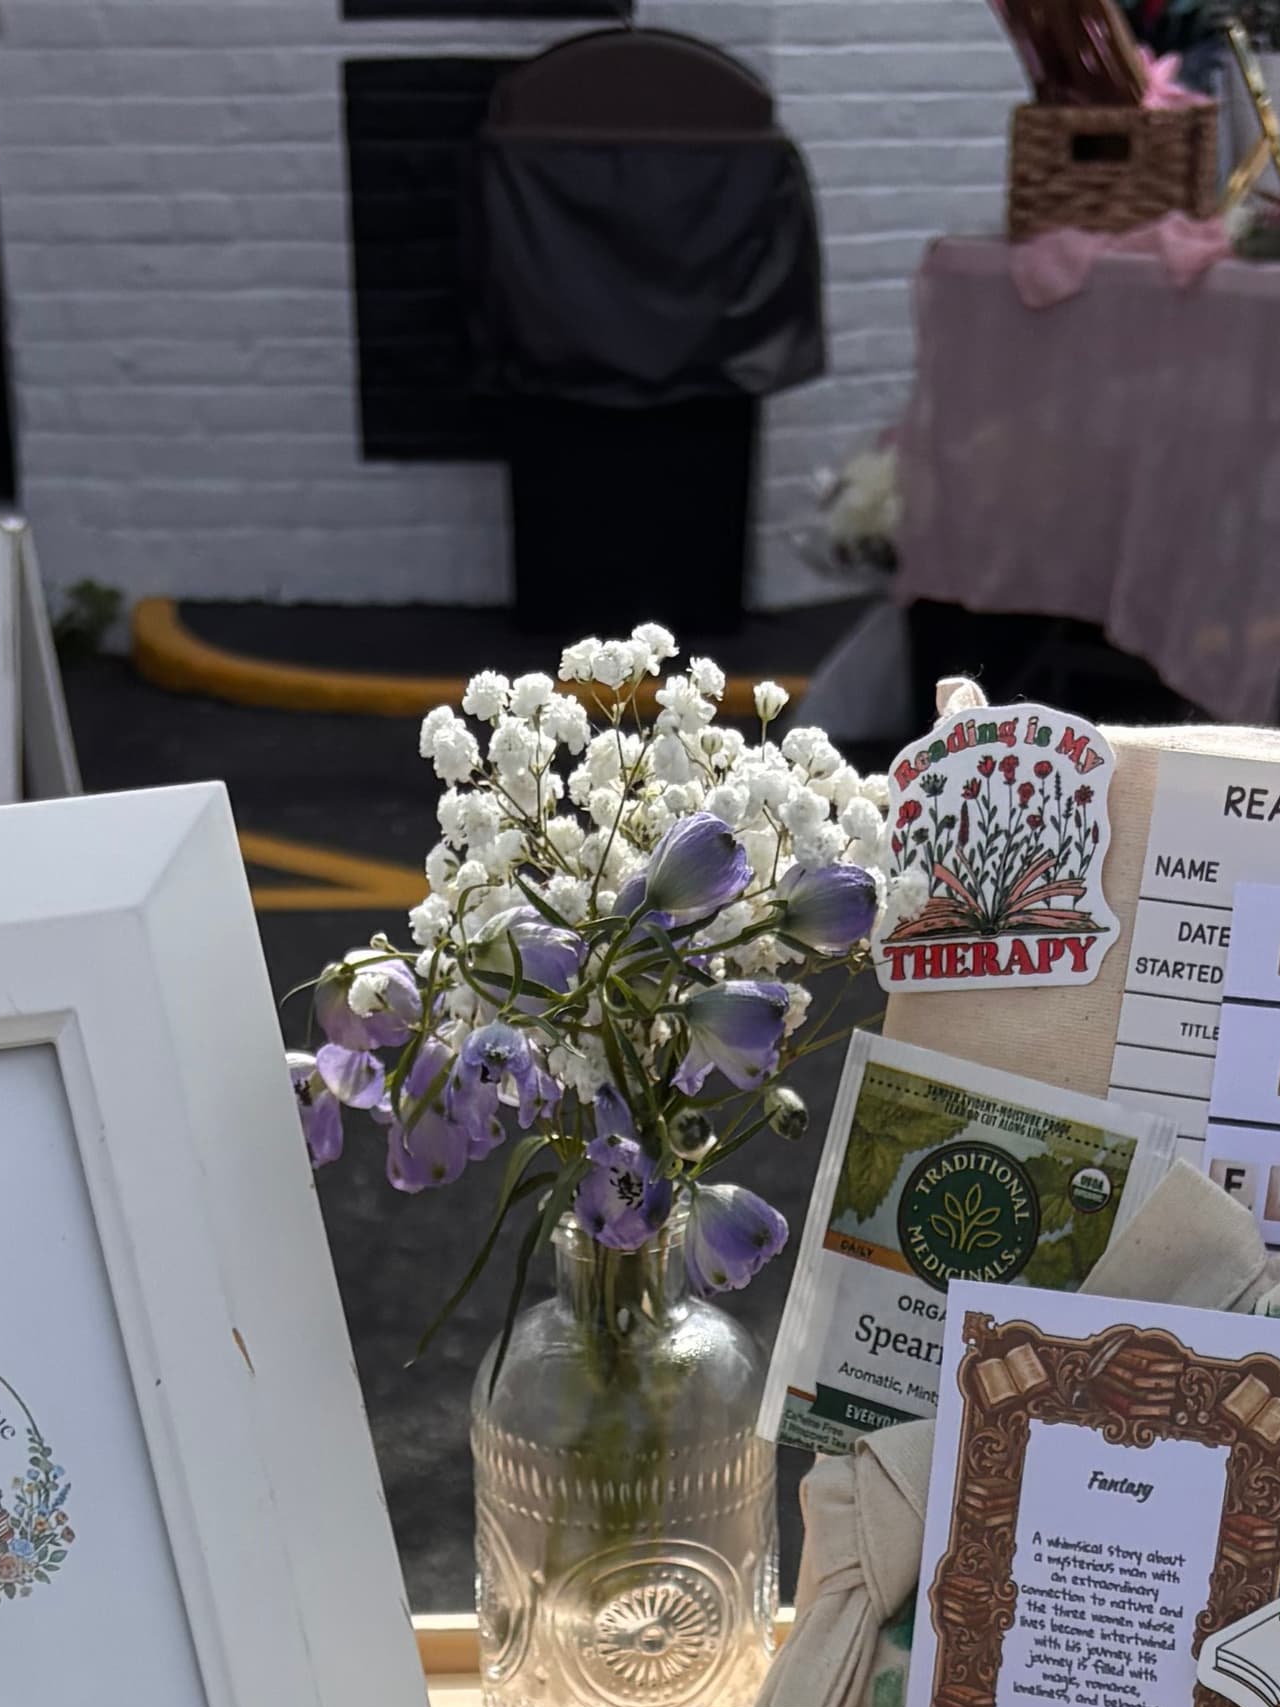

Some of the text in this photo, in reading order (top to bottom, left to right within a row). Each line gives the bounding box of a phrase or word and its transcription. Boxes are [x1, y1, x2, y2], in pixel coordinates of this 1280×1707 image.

[894, 716, 1104, 790] Reading is My
[1154, 855, 1219, 883] NAME
[1178, 921, 1231, 948] DATE
[884, 936, 1097, 980] THERAPY
[1135, 957, 1223, 984] STARTED
[981, 1113, 997, 1126] CUT
[916, 1153, 1030, 1224] TRADITIONAL
[840, 1240, 874, 1259] DAILY
[1088, 1470, 1154, 1503] Fantasy
[1032, 1531, 1186, 1567] A whimsical story about
[1034, 1552, 1180, 1584] a mysterious man with
[1021, 1584, 1183, 1618] connection to nature and
[1051, 1572, 1159, 1602] an extraordinary
[1020, 1615, 1176, 1651] lives become intertwined
[1028, 1601, 1175, 1634] the three women whose
[1025, 1650, 1157, 1682] journey is filled with
[1034, 1635, 1157, 1665] with his His
[1076, 1694, 1098, 1706] and
